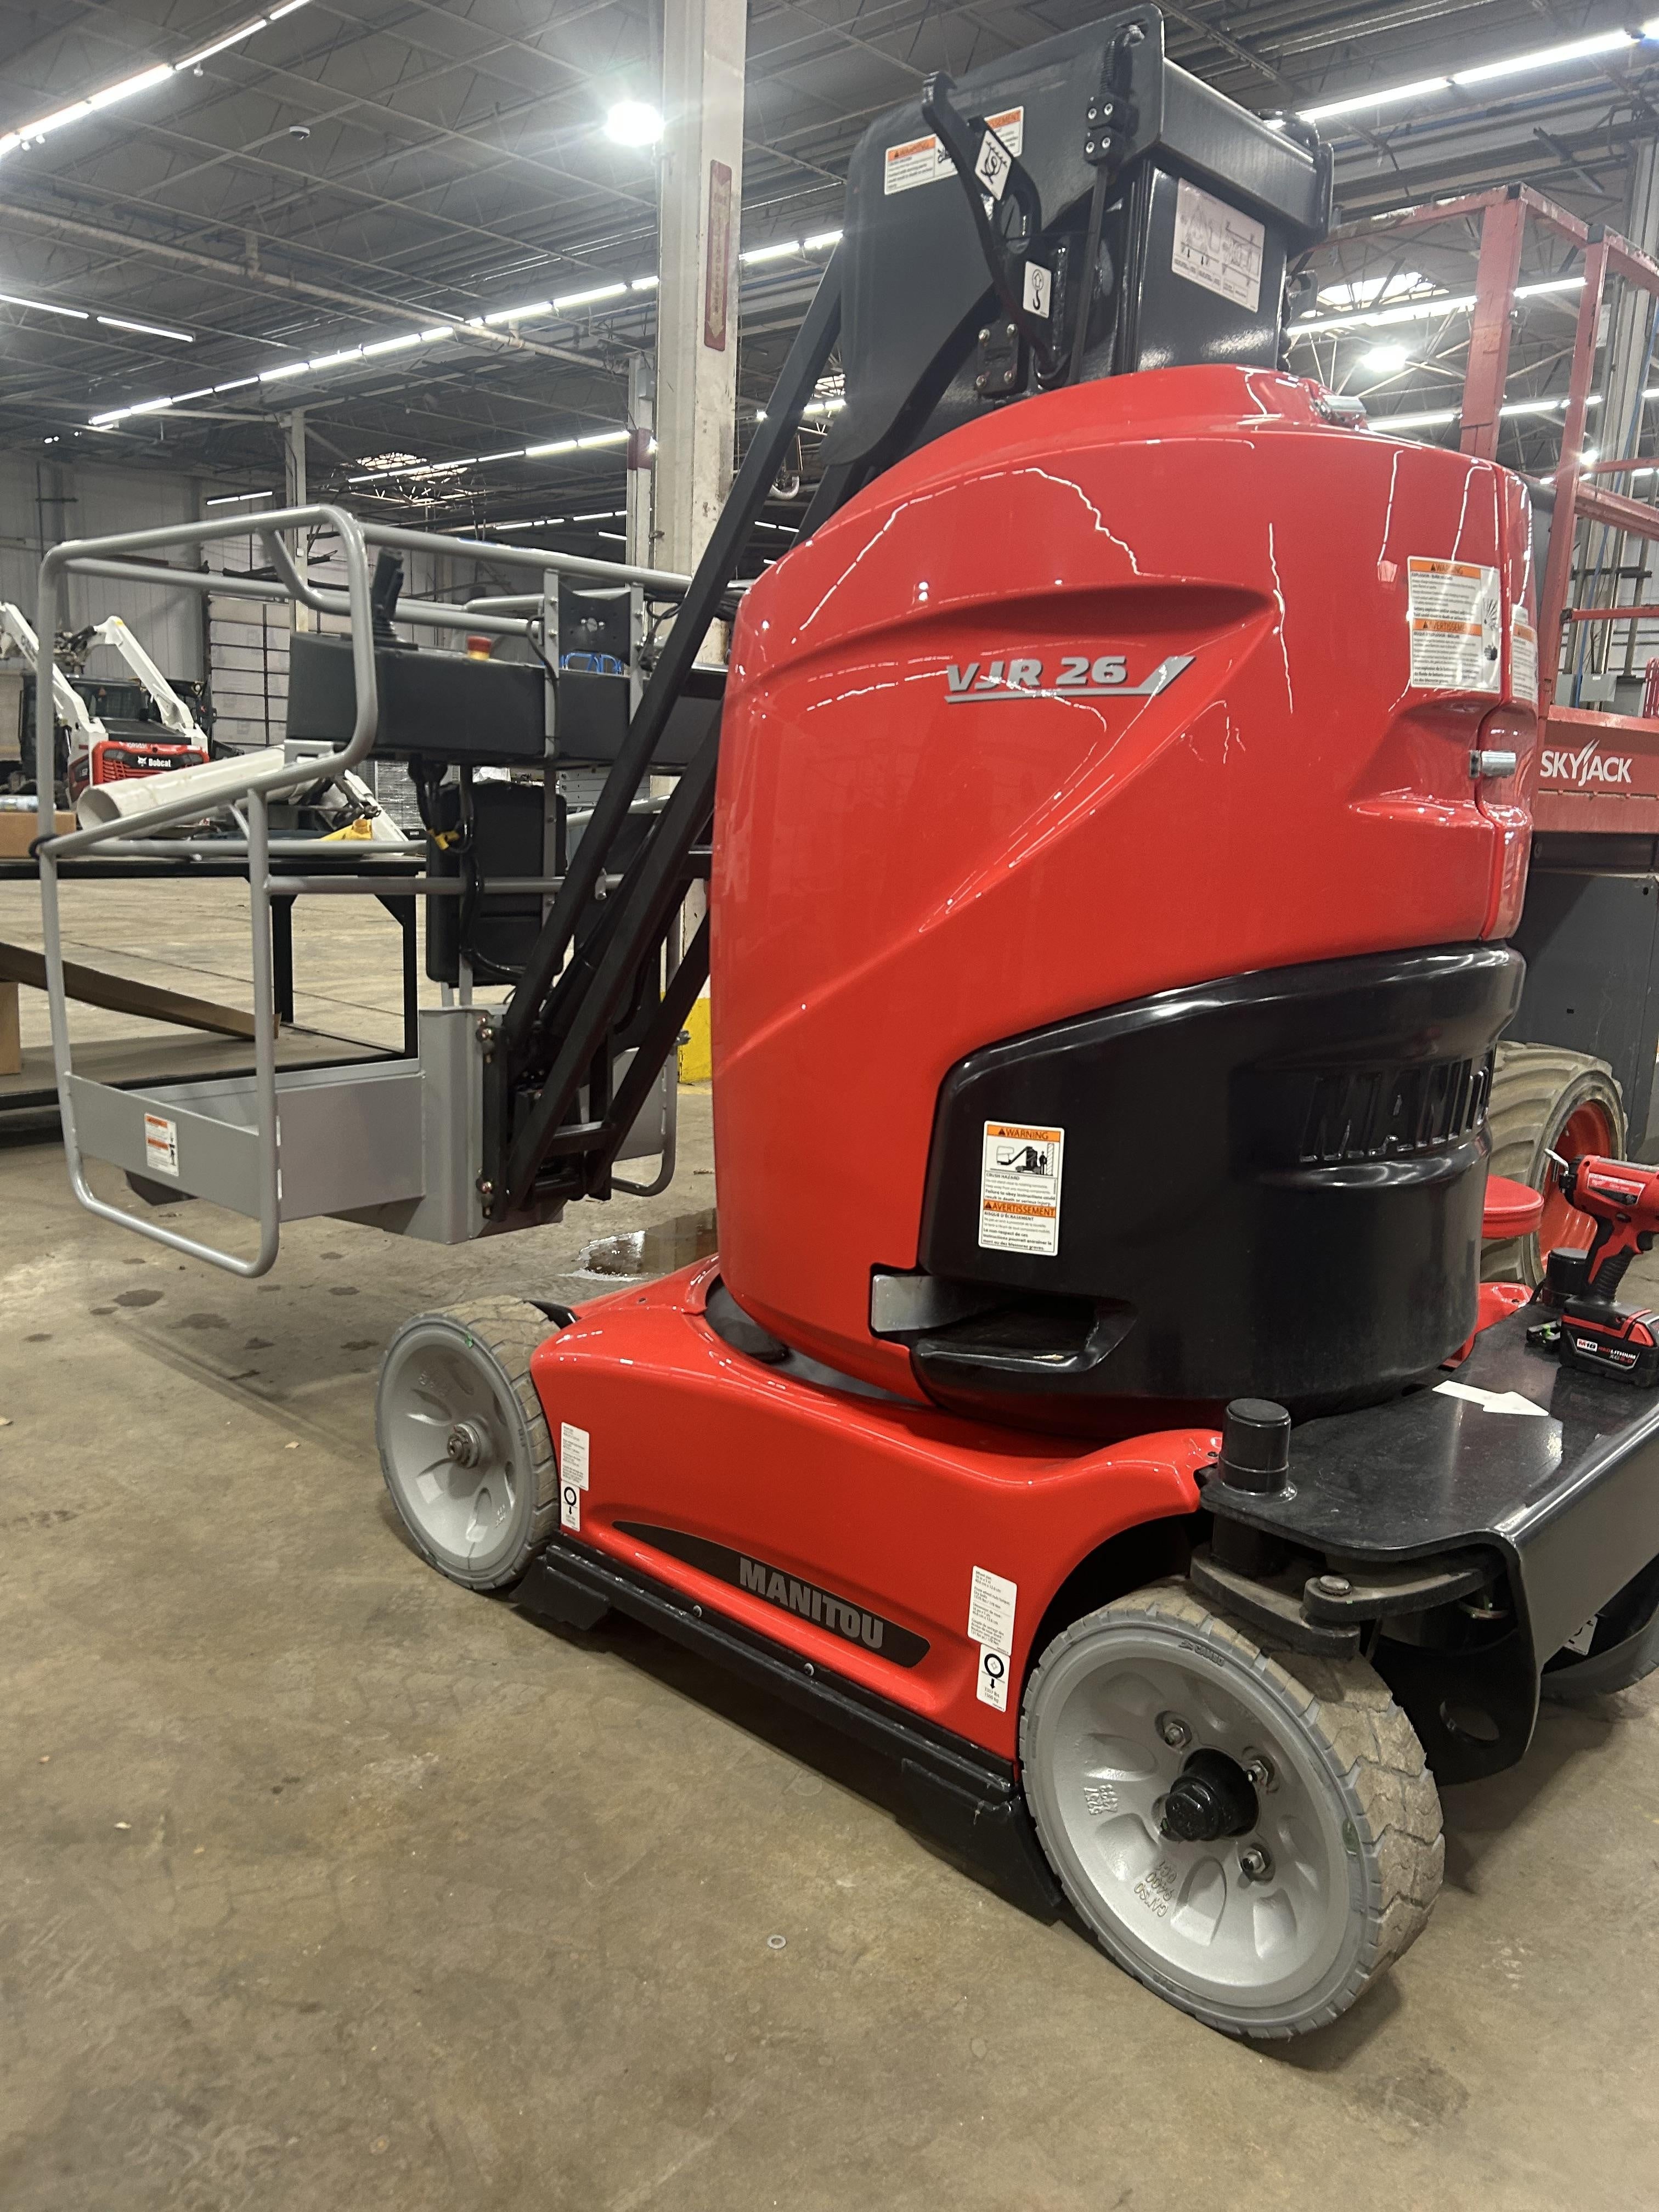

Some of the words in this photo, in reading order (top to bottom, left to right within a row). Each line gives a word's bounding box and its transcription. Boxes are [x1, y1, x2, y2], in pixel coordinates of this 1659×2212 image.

[946, 658, 1042, 692] VJR
[1055, 656, 1127, 685] 26
[148, 758, 171, 768] Bobcat
[1540, 738, 1633, 787] SKYJACK
[1006, 1127, 1048, 1140] WARNING
[992, 1203, 1054, 1216] AVERTISSEMENT
[1578, 1340, 1595, 1348] M18
[740, 1556, 883, 1649] MANITOU
